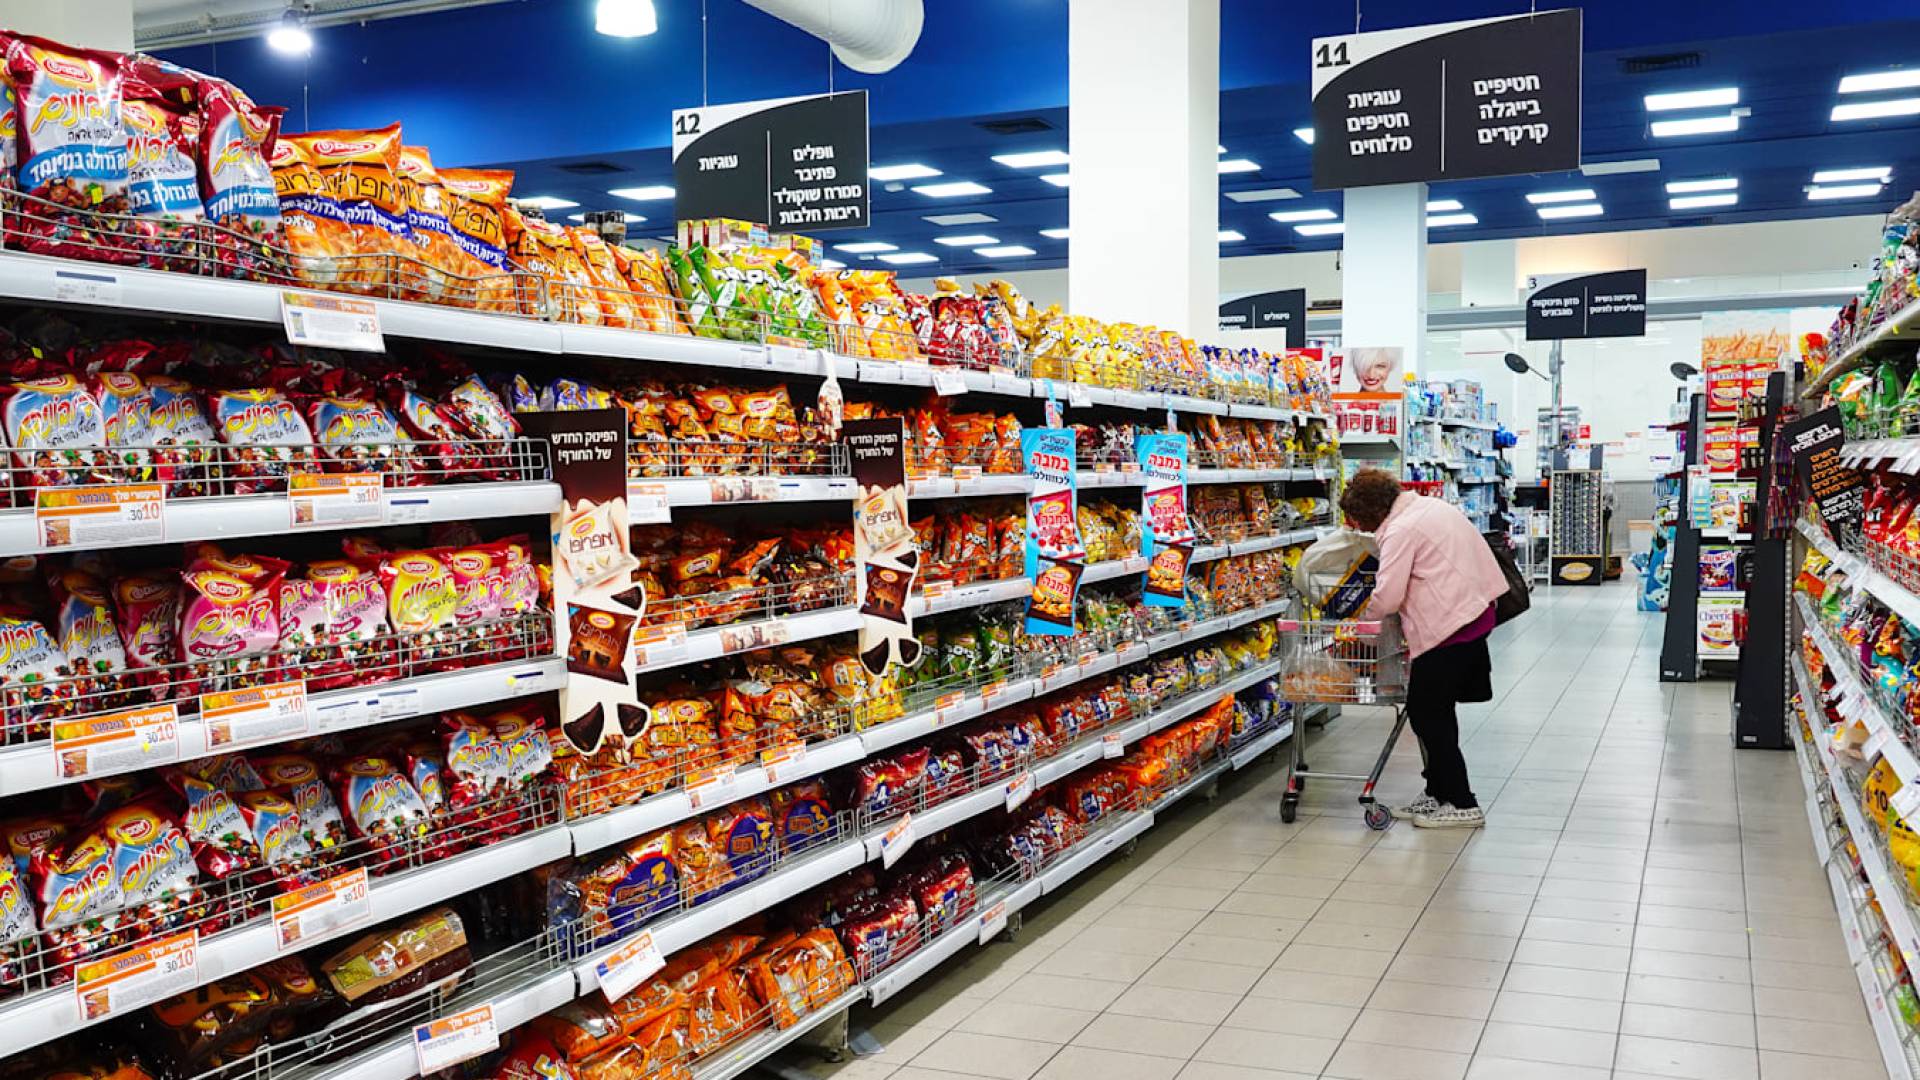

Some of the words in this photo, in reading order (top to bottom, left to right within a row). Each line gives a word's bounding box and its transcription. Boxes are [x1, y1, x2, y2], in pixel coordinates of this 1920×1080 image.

[1316, 42, 1351, 68] 11
[1473, 74, 1540, 96] חטיפים
[1347, 88, 1401, 109] עוגיות
[1480, 98, 1541, 120] בייגלה
[675, 113, 700, 136] 12
[1346, 111, 1410, 132] חטיפים
[1477, 123, 1549, 146] קרקרים
[1350, 133, 1413, 155] מלוחים
[792, 145, 834, 162] וופלים
[698, 155, 738, 171] עוגיות
[794, 166, 836, 182] פתיבר
[773, 188, 821, 207] שוקולד
[824, 184, 862, 200] ממרח
[779, 208, 822, 225] חלבות
[824, 205, 860, 220] ריבות
[1529, 278, 1536, 288] 3
[551, 431, 583, 444] החדש
[585, 431, 618, 447] הפינוק
[850, 435, 873, 445] החדש
[873, 433, 898, 446] הפינוק
[558, 449, 594, 465] החורף!
[595, 448, 612, 461] של
[881, 446, 894, 457] של
[1032, 451, 1070, 472] במבה
[1148, 454, 1181, 471] במבה
